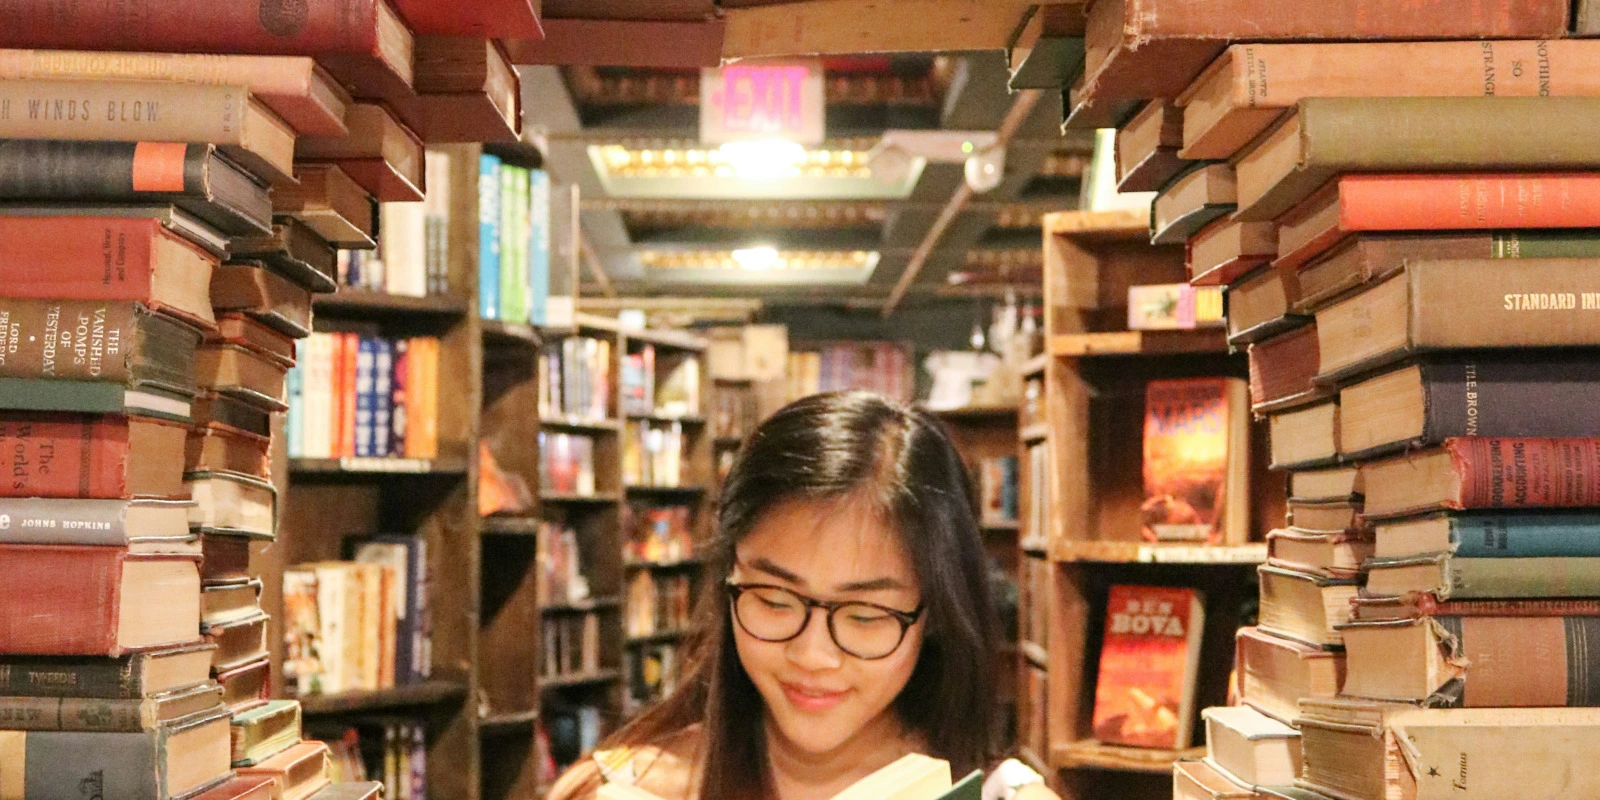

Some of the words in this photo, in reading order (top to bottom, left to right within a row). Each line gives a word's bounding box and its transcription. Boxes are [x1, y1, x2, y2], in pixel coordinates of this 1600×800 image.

[1511, 60, 1524, 77] SO
[1536, 40, 1550, 97] NOTHING
[28, 99, 91, 121] WINDS
[107, 100, 162, 122] BLOW
[722, 65, 810, 131] EXIT
[115, 233, 126, 266] Company
[117, 267, 125, 281] and
[1503, 293, 1577, 311] STANDARD
[9, 322, 20, 353] LORD
[42, 306, 60, 376] YESTERDAY
[60, 330, 71, 348] OF
[73, 315, 89, 365] POMPS
[89, 308, 106, 376] VANISHED
[107, 328, 120, 355] THE
[13, 424, 31, 489] World's
[39, 440, 55, 475] The
[1512, 442, 1527, 504] ACCOUNTING
[1489, 440, 1504, 507] BOOKKEEPING
[21, 518, 57, 529] JOHNS
[62, 518, 111, 530] HOPKINS
[1110, 613, 1184, 636] BOVA
[28, 671, 77, 685] TWEEDIE
[1451, 751, 1468, 792] Tornius
